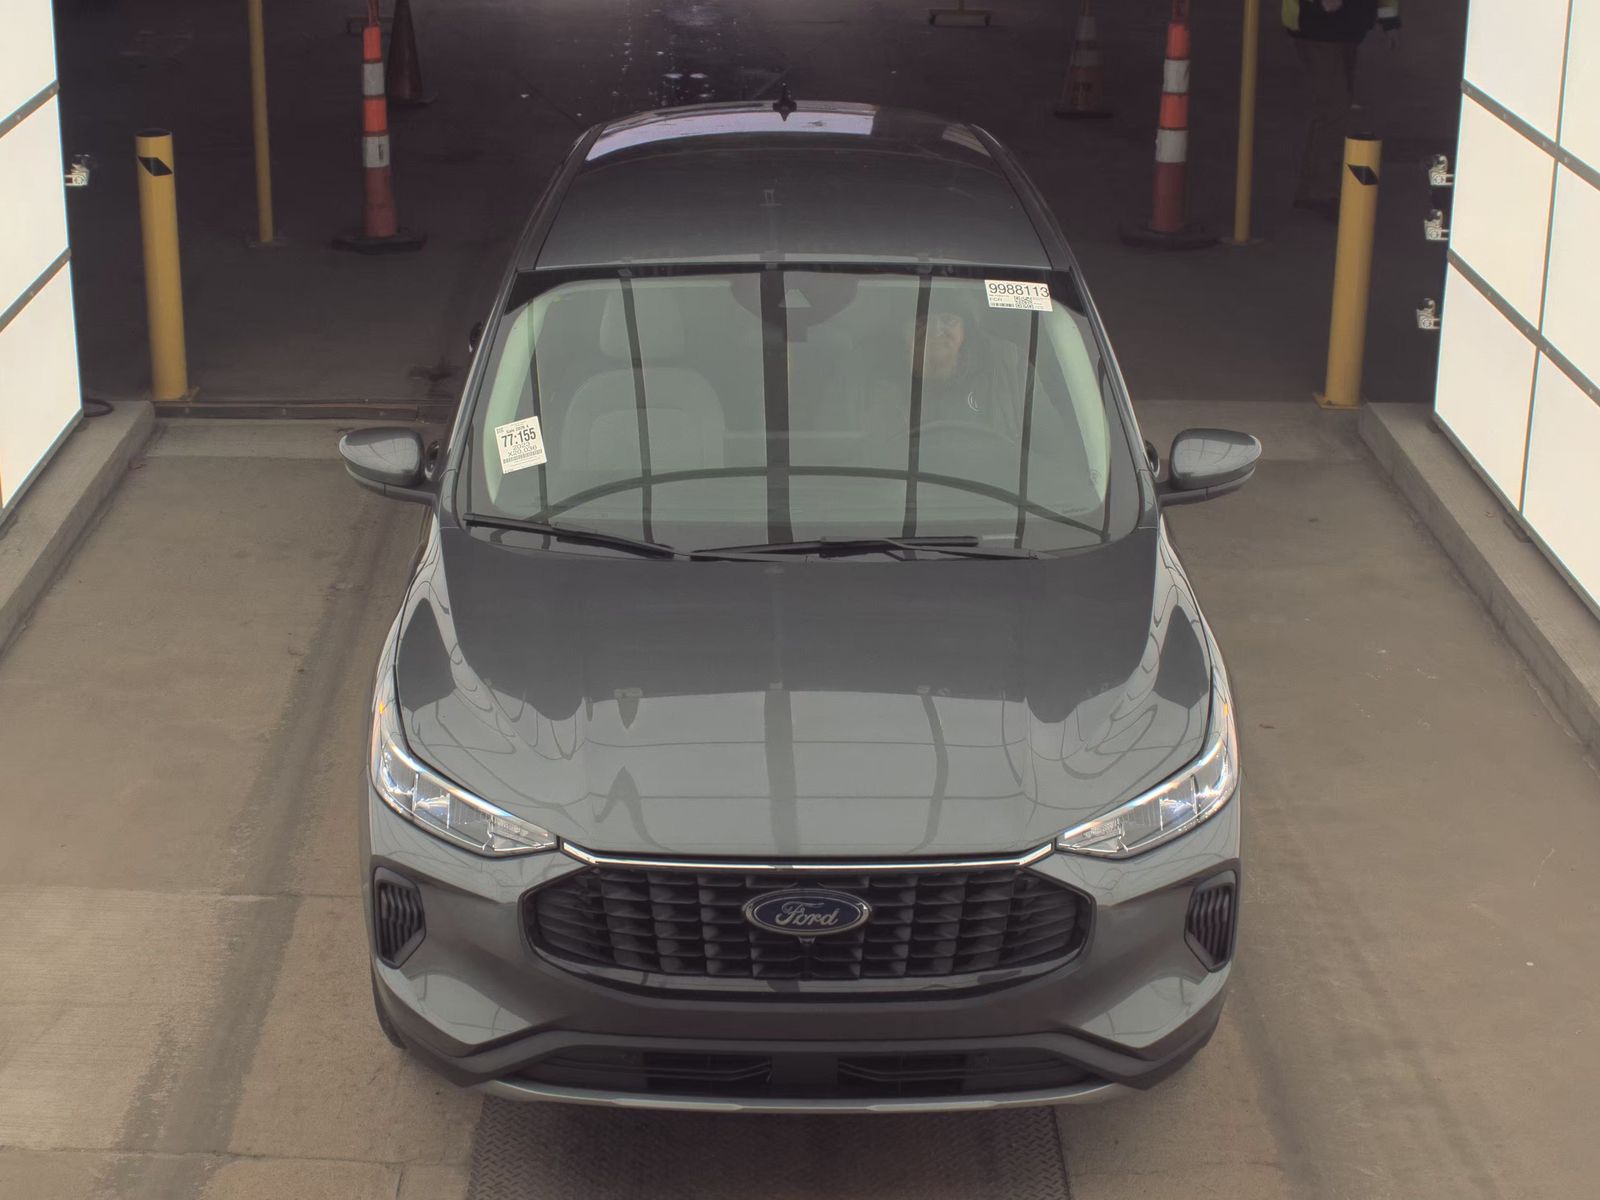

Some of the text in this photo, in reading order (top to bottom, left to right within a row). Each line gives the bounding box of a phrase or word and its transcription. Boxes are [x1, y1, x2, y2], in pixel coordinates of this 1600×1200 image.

[989, 283, 1050, 297] 9988113
[501, 427, 536, 447] 77:155
[512, 441, 531, 450] 2023
[775, 901, 840, 925] Ford
